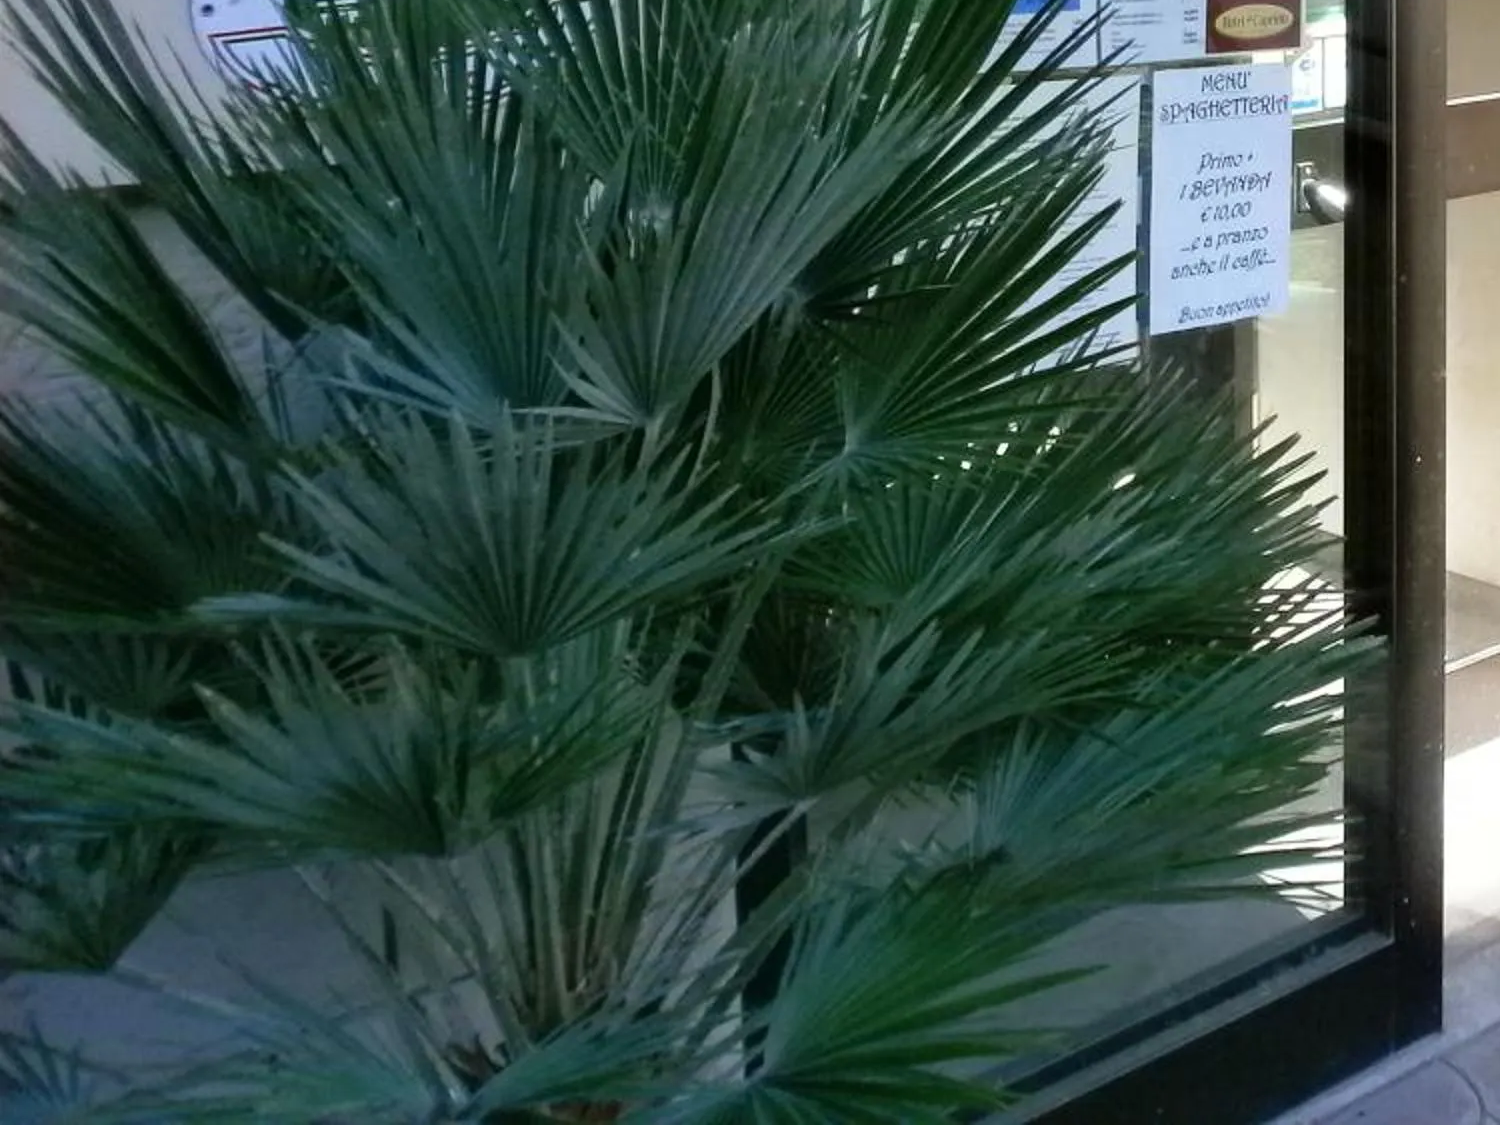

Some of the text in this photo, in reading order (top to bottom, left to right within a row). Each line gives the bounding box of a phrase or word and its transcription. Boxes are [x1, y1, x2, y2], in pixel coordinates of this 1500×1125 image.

[1215, 226, 1269, 251] pranzo
[1170, 258, 1217, 281] anche
[1219, 252, 1230, 272] il
